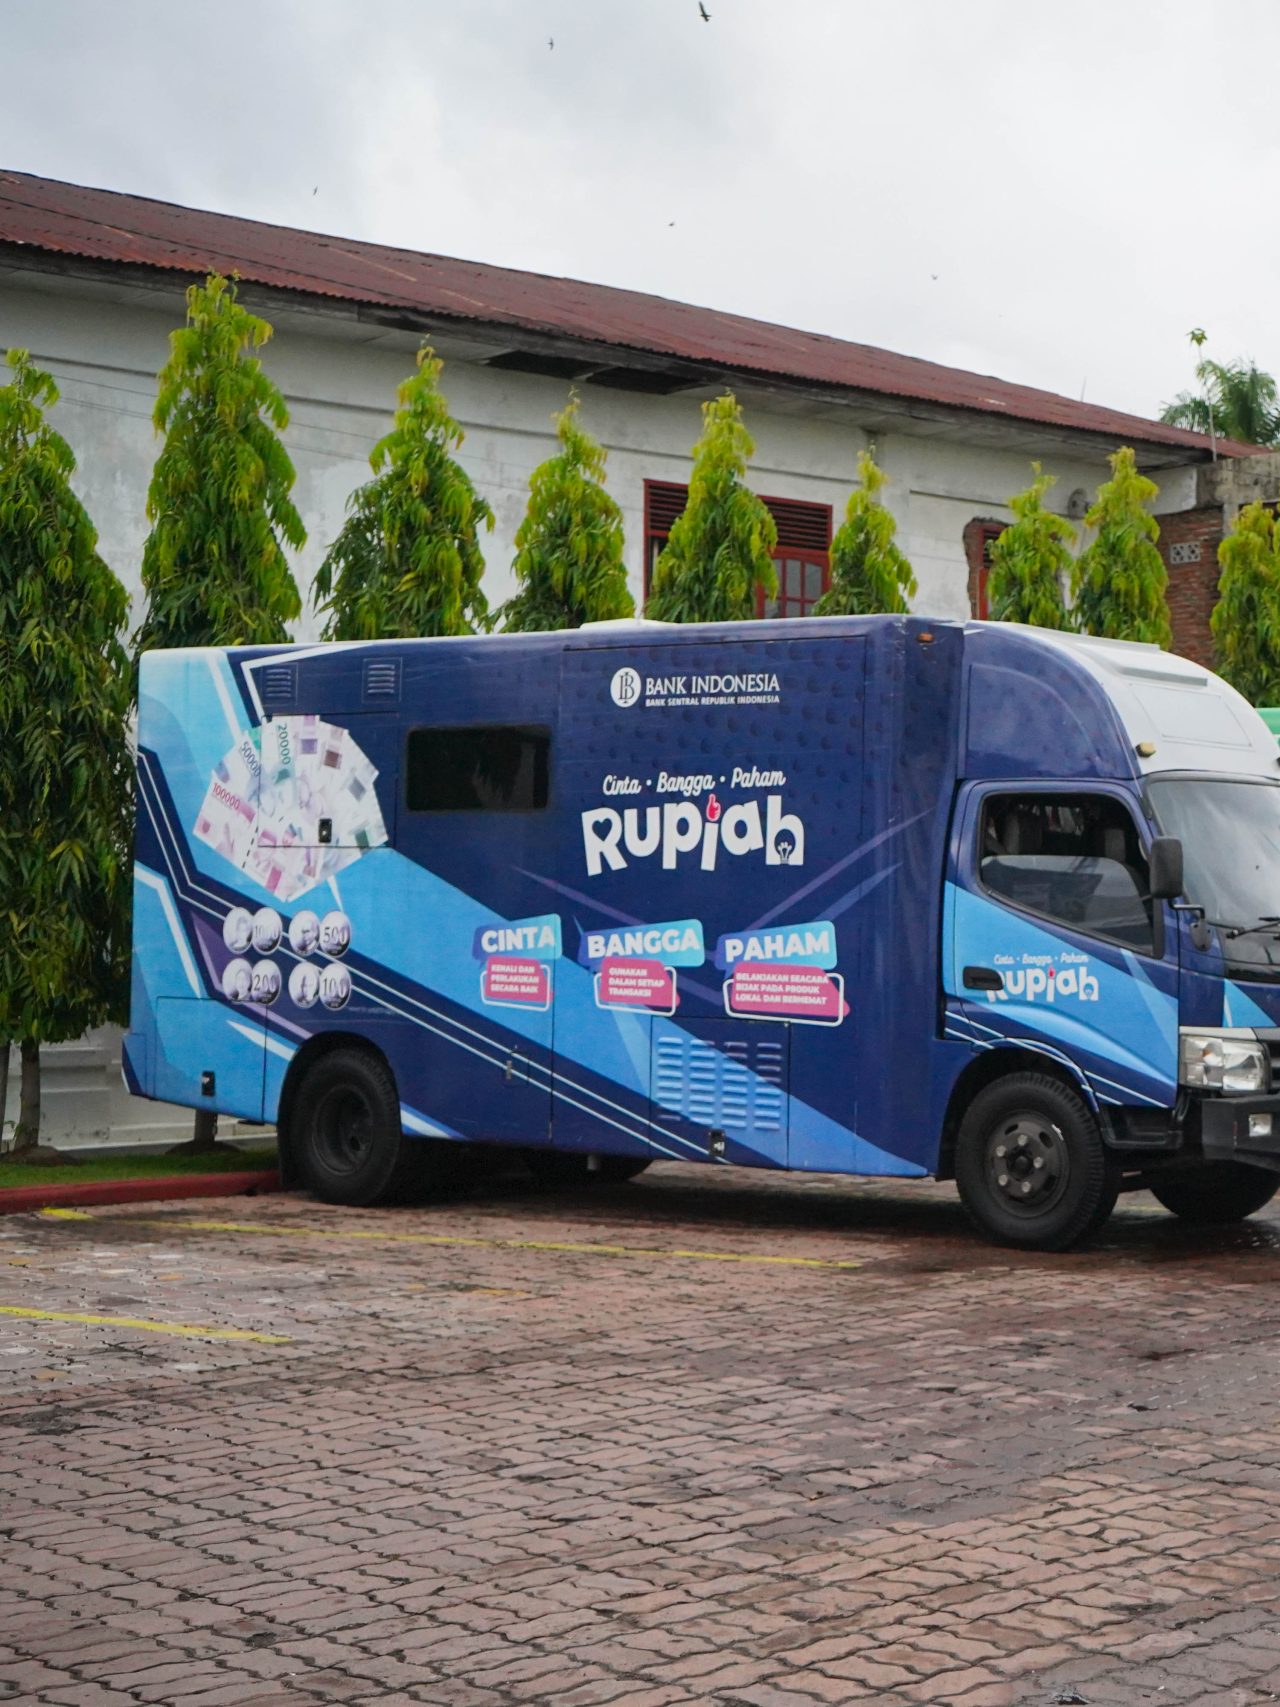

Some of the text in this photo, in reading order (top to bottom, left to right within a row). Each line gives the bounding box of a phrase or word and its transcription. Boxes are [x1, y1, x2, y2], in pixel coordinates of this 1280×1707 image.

[645, 674, 781, 696] BANK INDONESIA
[645, 695, 780, 707] BANK SENTRAL REPUBLIK INDONESIA
[239, 741, 262, 777] 50000
[276, 724, 291, 766] 20000
[602, 766, 787, 797] Cinta Bangga Paham
[213, 782, 241, 811] 100000
[581, 793, 805, 876] Rupiah
[322, 927, 350, 945] 500
[481, 925, 556, 953] CINTA
[587, 928, 700, 958] BANGGA
[725, 931, 830, 963] PAHAM
[254, 974, 278, 992] 200
[608, 977, 637, 987] DALAM
